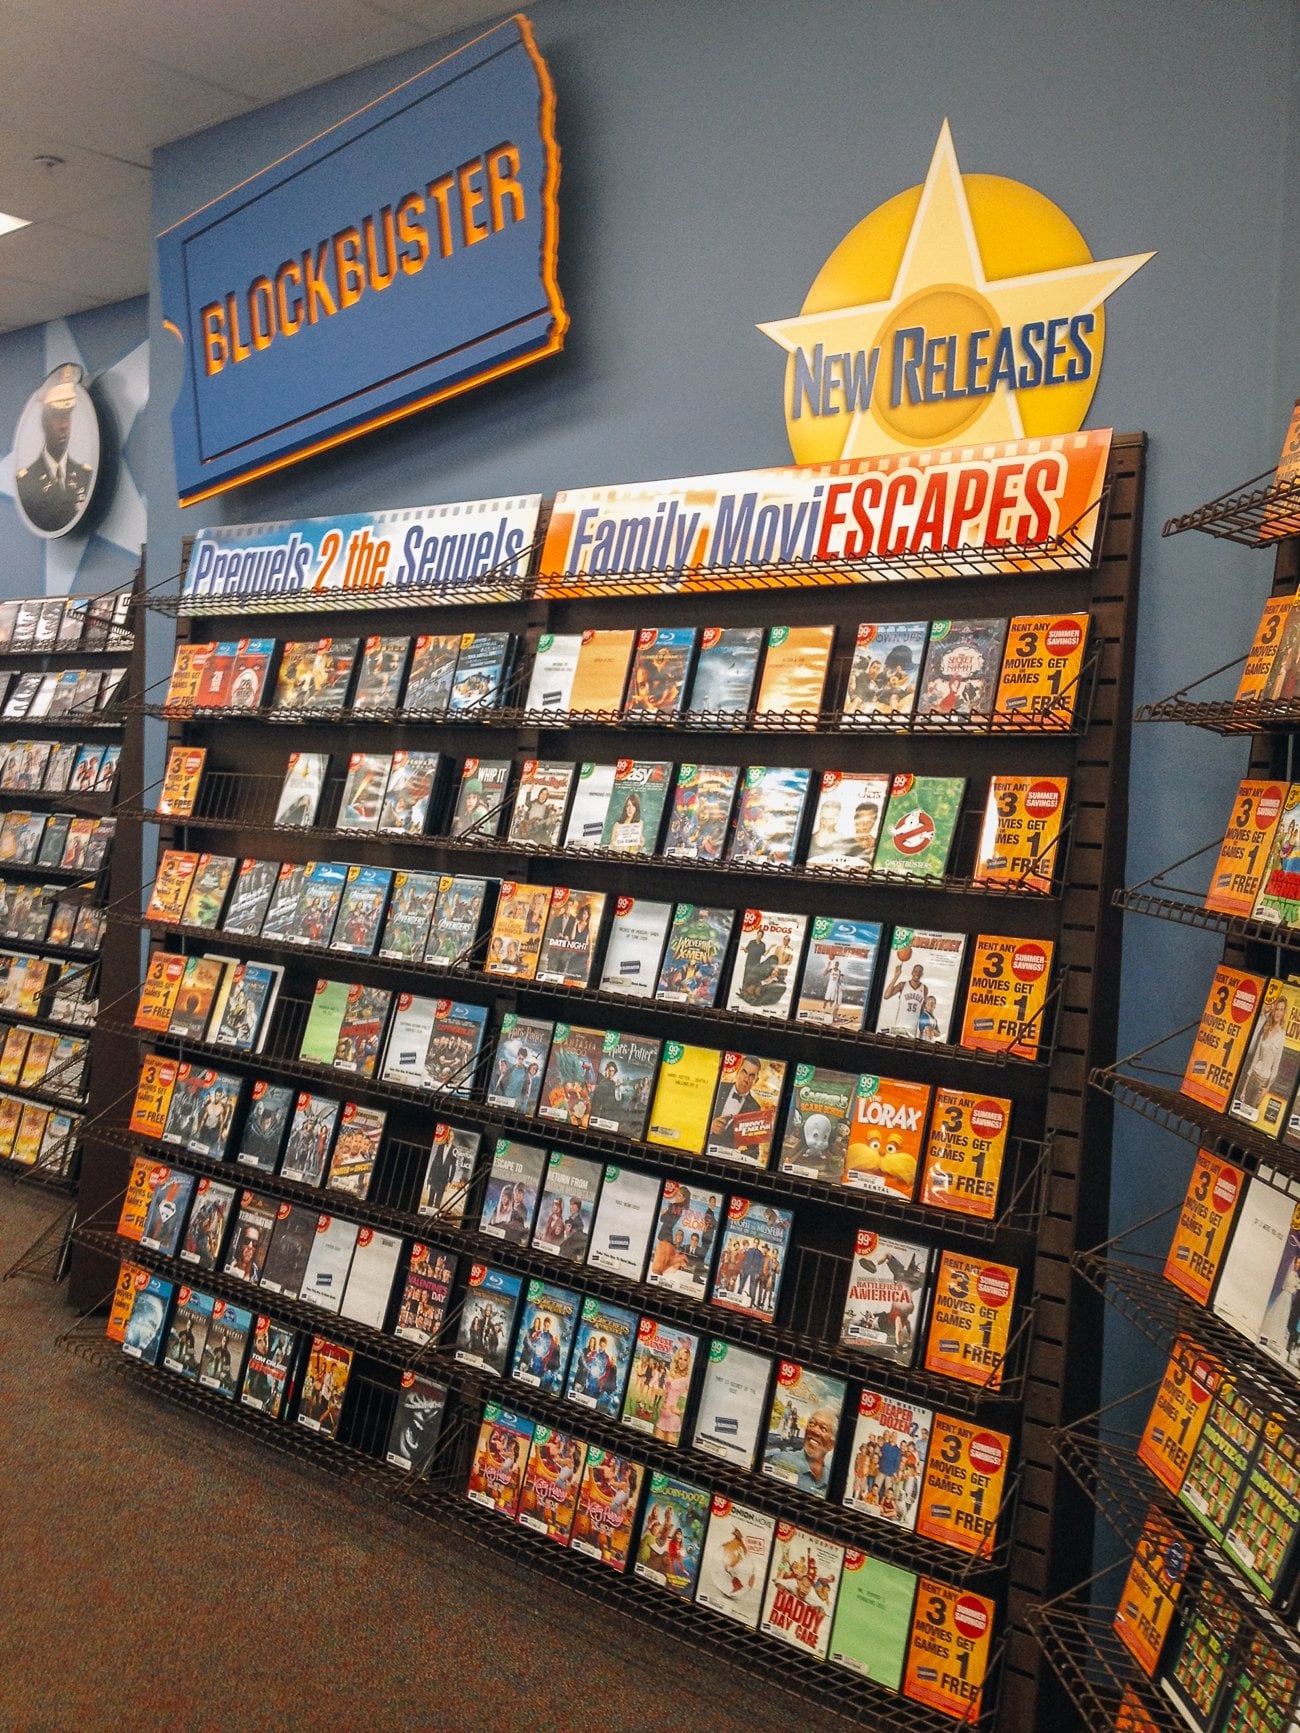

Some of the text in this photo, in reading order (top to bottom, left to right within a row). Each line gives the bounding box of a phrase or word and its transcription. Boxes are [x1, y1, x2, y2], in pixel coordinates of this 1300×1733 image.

[201, 140, 526, 376] BLOCKBUSTER
[793, 313, 1095, 420] NEW RELEASES
[566, 500, 700, 587] Family
[192, 517, 525, 600] Prequels 2 the Sequels
[1011, 623, 1049, 632] RENT ANY
[1048, 630, 1080, 639] SUMMER
[1261, 615, 1280, 644] 3
[1016, 633, 1037, 657] 3
[1046, 638, 1080, 646] SAVINGS!
[1250, 645, 1278, 657] MOVIES
[1005, 658, 1068, 668] MOVIES GET
[1245, 663, 1271, 675] GAMES
[1003, 670, 1062, 694] GAMES 1
[1031, 696, 1071, 710] FREE
[172, 758, 183, 773] 3
[1013, 783, 1030, 791] ANY
[1027, 792, 1059, 800] SUMMER
[997, 792, 1018, 817] 3
[1026, 800, 1058, 808] SAVINGS!
[1236, 798, 1253, 828] 3
[1027, 820, 1047, 830] GET
[1226, 828, 1266, 845] MOVIES GET
[1026, 832, 1042, 857] 1
[1221, 845, 1259, 875] GAMES 1
[1231, 874, 1259, 894] FREE
[978, 942, 1017, 953] RENT ANY
[1014, 953, 1045, 963] SUMMER
[153, 964, 164, 979] 3
[983, 953, 1005, 978] 3
[1012, 961, 1045, 972] SAVINGS!
[162, 991, 171, 1007] 1
[972, 978, 1034, 995] MOVIES GET
[971, 993, 1029, 1021] GAMES 1
[1212, 986, 1229, 1016] 3
[998, 1020, 1037, 1039] FREE
[1202, 1012, 1242, 1038] MOVIES GET
[1198, 1030, 1235, 1068] GAMES 1
[146, 1068, 156, 1084] 3
[1206, 1063, 1233, 1090] FREE
[156, 1095, 162, 1112] 1
[937, 1095, 975, 1108] RENT ANY
[857, 1100, 922, 1132] LORAX
[942, 1106, 964, 1133] 3
[971, 1117, 1002, 1129] SAVINGS!
[973, 1109, 1003, 1121] SUMMER
[931, 1130, 992, 1151] MOVIES GET
[930, 1147, 986, 1177] GAMES 1
[956, 1176, 995, 1198] FREE
[1195, 1170, 1211, 1202] 3
[1186, 1196, 1223, 1227] MOVIES GET
[1180, 1214, 1216, 1258] GAMES 1
[944, 1258, 963, 1269] RENT
[1189, 1250, 1215, 1282] FREE
[850, 1286, 911, 1303] AMERICA
[948, 1271, 969, 1298] 3
[431, 1291, 447, 1304] DAY
[937, 1295, 999, 1320] MOVIES GET
[936, 1311, 992, 1348] GAMES 1
[963, 1343, 1002, 1368] FREE
[937, 1419, 973, 1438] RENT ANY
[1176, 1415, 1191, 1445] 1
[941, 1435, 962, 1464] 3
[1163, 1436, 1188, 1471] FREE
[929, 1458, 991, 1488] MOVIES GET
[928, 1474, 984, 1516] GAMES 1
[772, 1590, 826, 1632] DADDY
[926, 1597, 947, 1626] 3
[793, 1623, 820, 1650] CARE
[916, 1619, 976, 1652] MOVIES GET
[914, 1636, 970, 1679] GAMES 1
